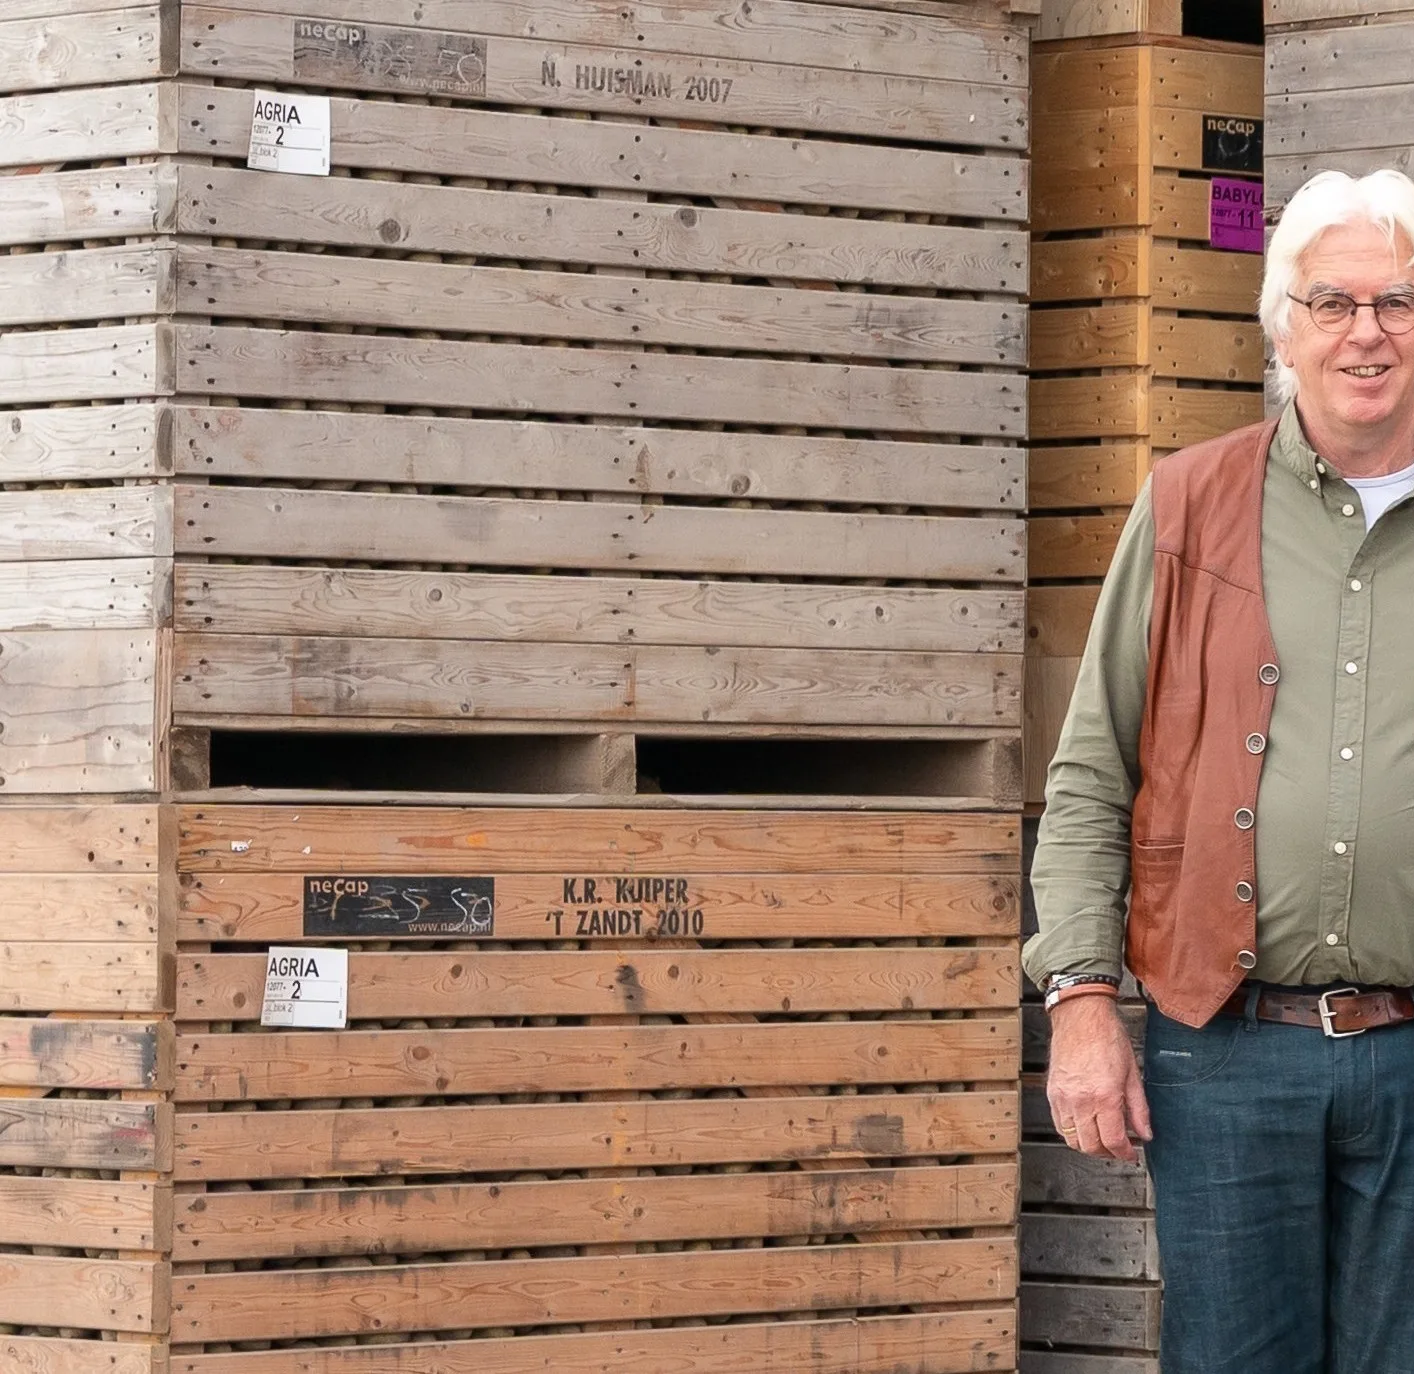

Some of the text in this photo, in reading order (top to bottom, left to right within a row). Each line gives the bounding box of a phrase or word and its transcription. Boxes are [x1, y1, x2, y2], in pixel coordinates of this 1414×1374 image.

[541, 60, 733, 104] N. HUISMAN 2007
[254, 99, 301, 124] AGRIA
[275, 125, 285, 146] 2
[1237, 208, 1255, 230] 11
[563, 877, 690, 905] K.R. KUIPER
[576, 909, 643, 936] ZANDT
[656, 909, 704, 936] 2010
[268, 957, 320, 978] AGRIA
[291, 980, 301, 1000] 2
